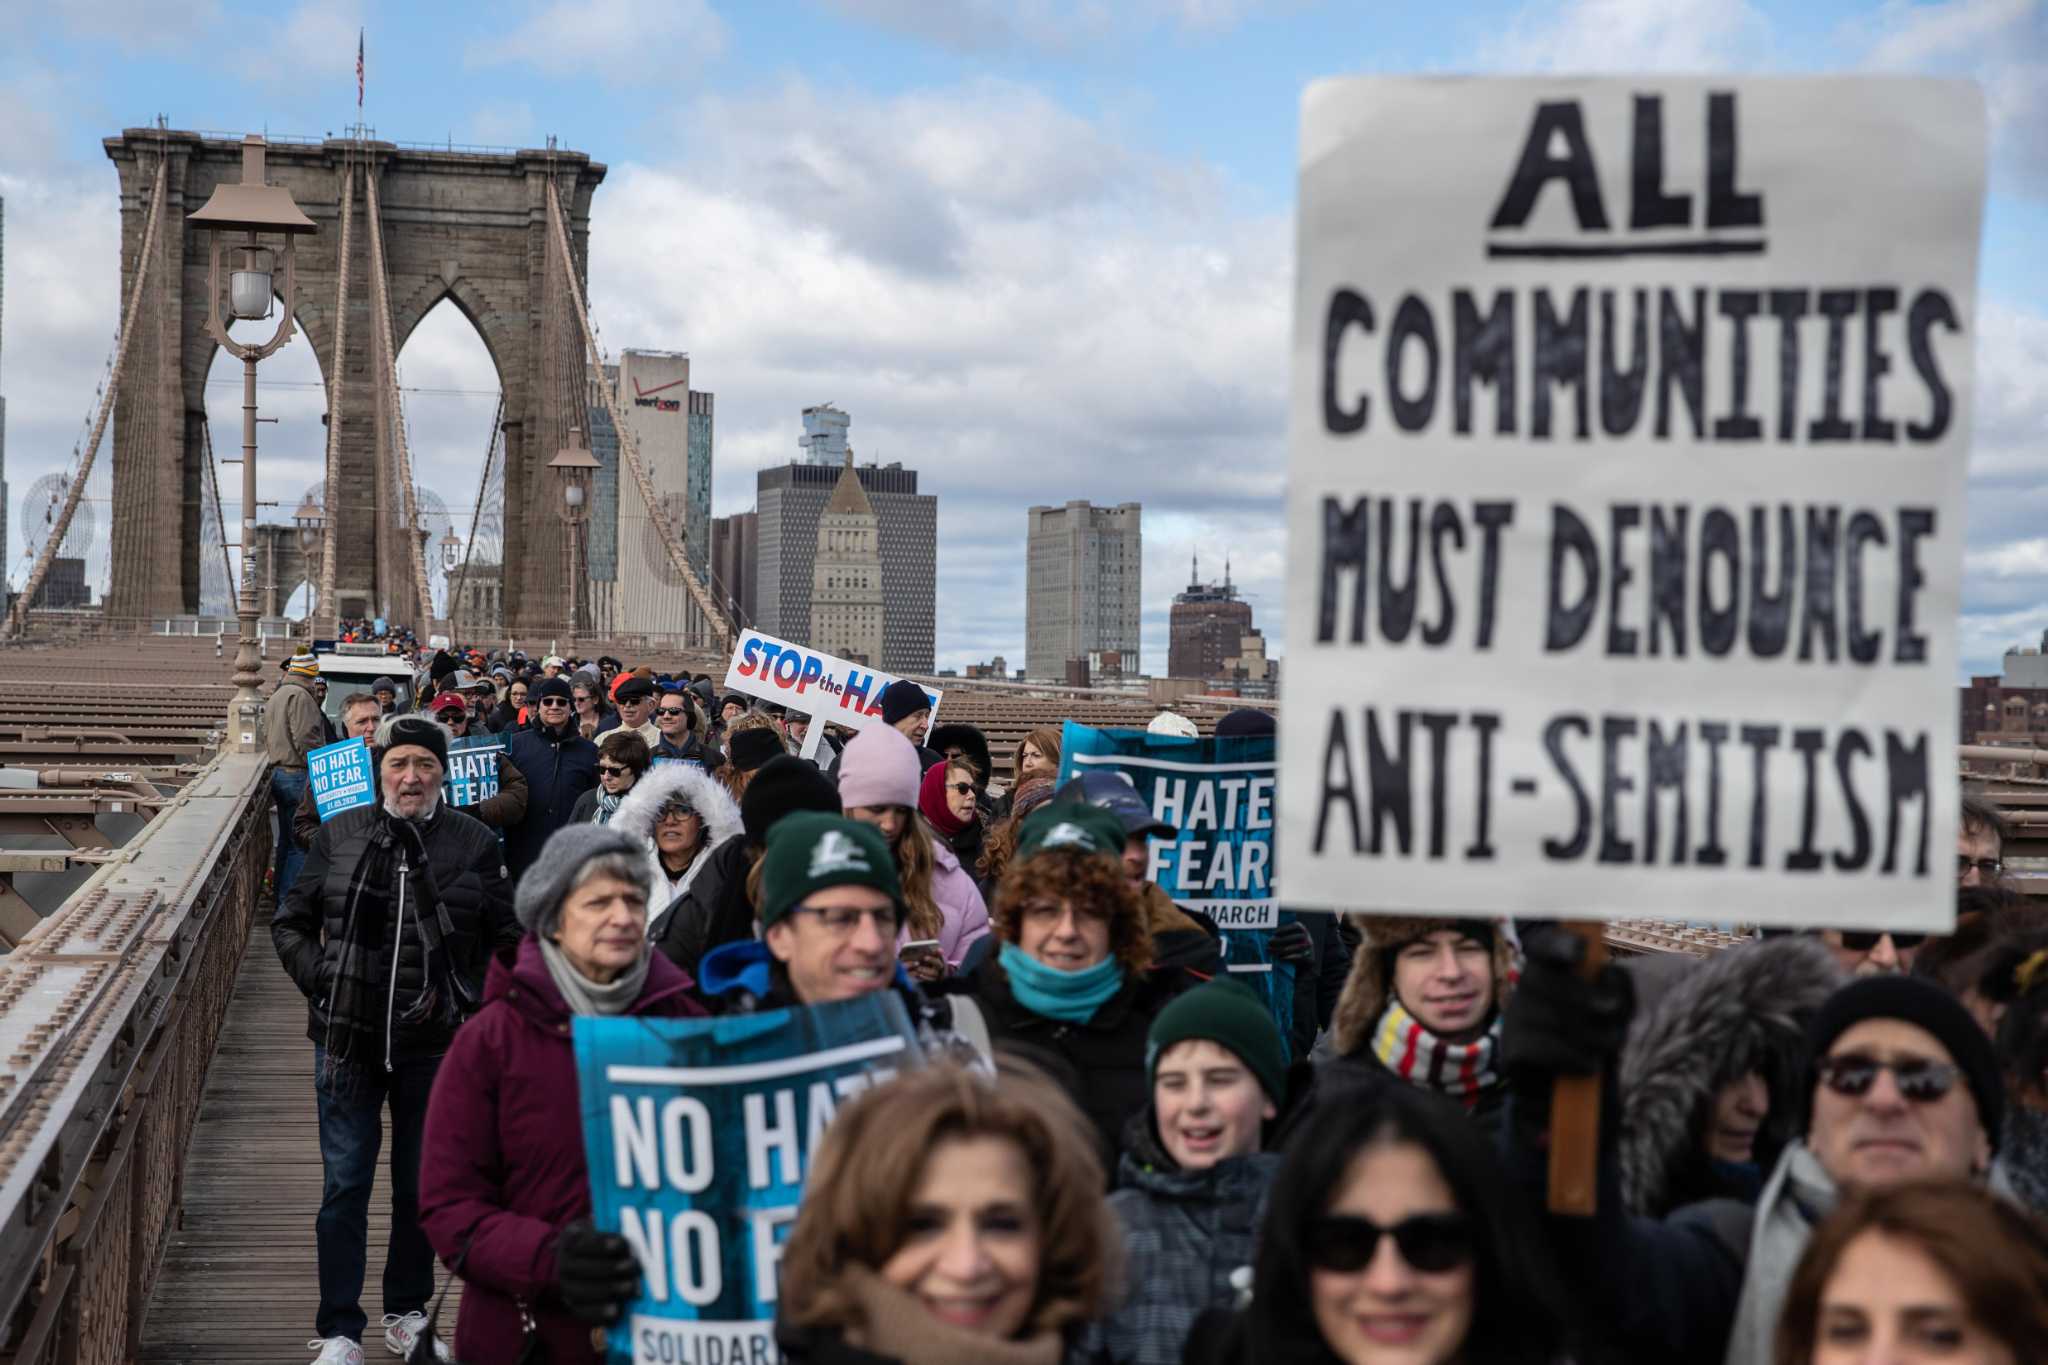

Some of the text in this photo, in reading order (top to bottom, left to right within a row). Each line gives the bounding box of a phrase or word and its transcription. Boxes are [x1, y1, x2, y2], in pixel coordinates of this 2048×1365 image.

[1487, 91, 1766, 232] ALL
[1320, 287, 1961, 445] COMMUNITIES
[1315, 496, 1938, 665] MUST DENOUNCE
[737, 637, 822, 694] STOP
[819, 673, 843, 695] the
[311, 748, 364, 776] NO HATE.
[314, 767, 366, 794] NO FEAR.
[448, 753, 498, 779] HATE
[453, 781, 498, 807] FEAR
[1152, 776, 1276, 830] HATE
[1312, 707, 1931, 876] ANTI-SEMITISM
[1203, 904, 1269, 924] MARCH
[609, 1094, 714, 1194] NO
[619, 1205, 722, 1306] NO
[642, 1328, 769, 1365] SOLIDAR
